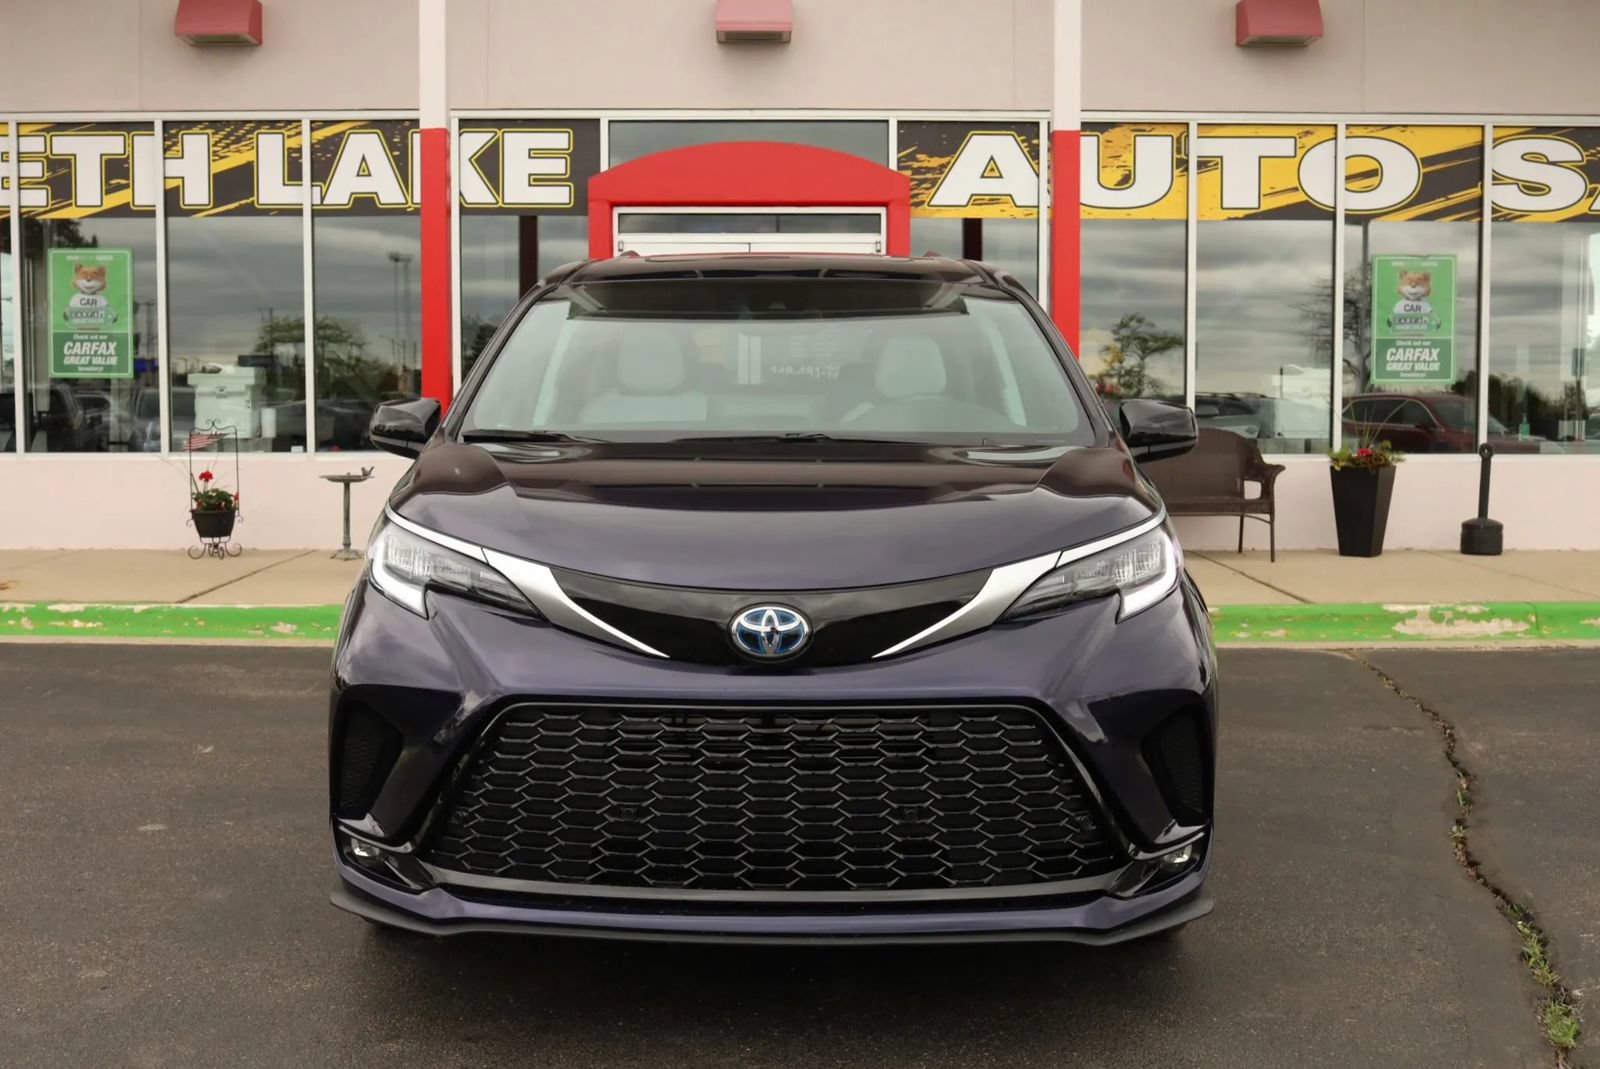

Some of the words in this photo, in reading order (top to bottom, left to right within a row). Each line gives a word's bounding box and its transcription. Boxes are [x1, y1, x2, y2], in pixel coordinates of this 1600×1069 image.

[254, 129, 574, 208] LAKE
[926, 131, 1423, 212] AUTO
[1486, 134, 1600, 214] S
[80, 298, 97, 306] CAR
[1403, 304, 1421, 312] CAR
[64, 341, 117, 355] CARFAX
[1386, 347, 1440, 361] CARFAX
[64, 356, 90, 365] GREAT
[92, 356, 118, 365] VALUE
[1386, 362, 1413, 371] GREAT
[1414, 362, 1440, 371] VALUE
